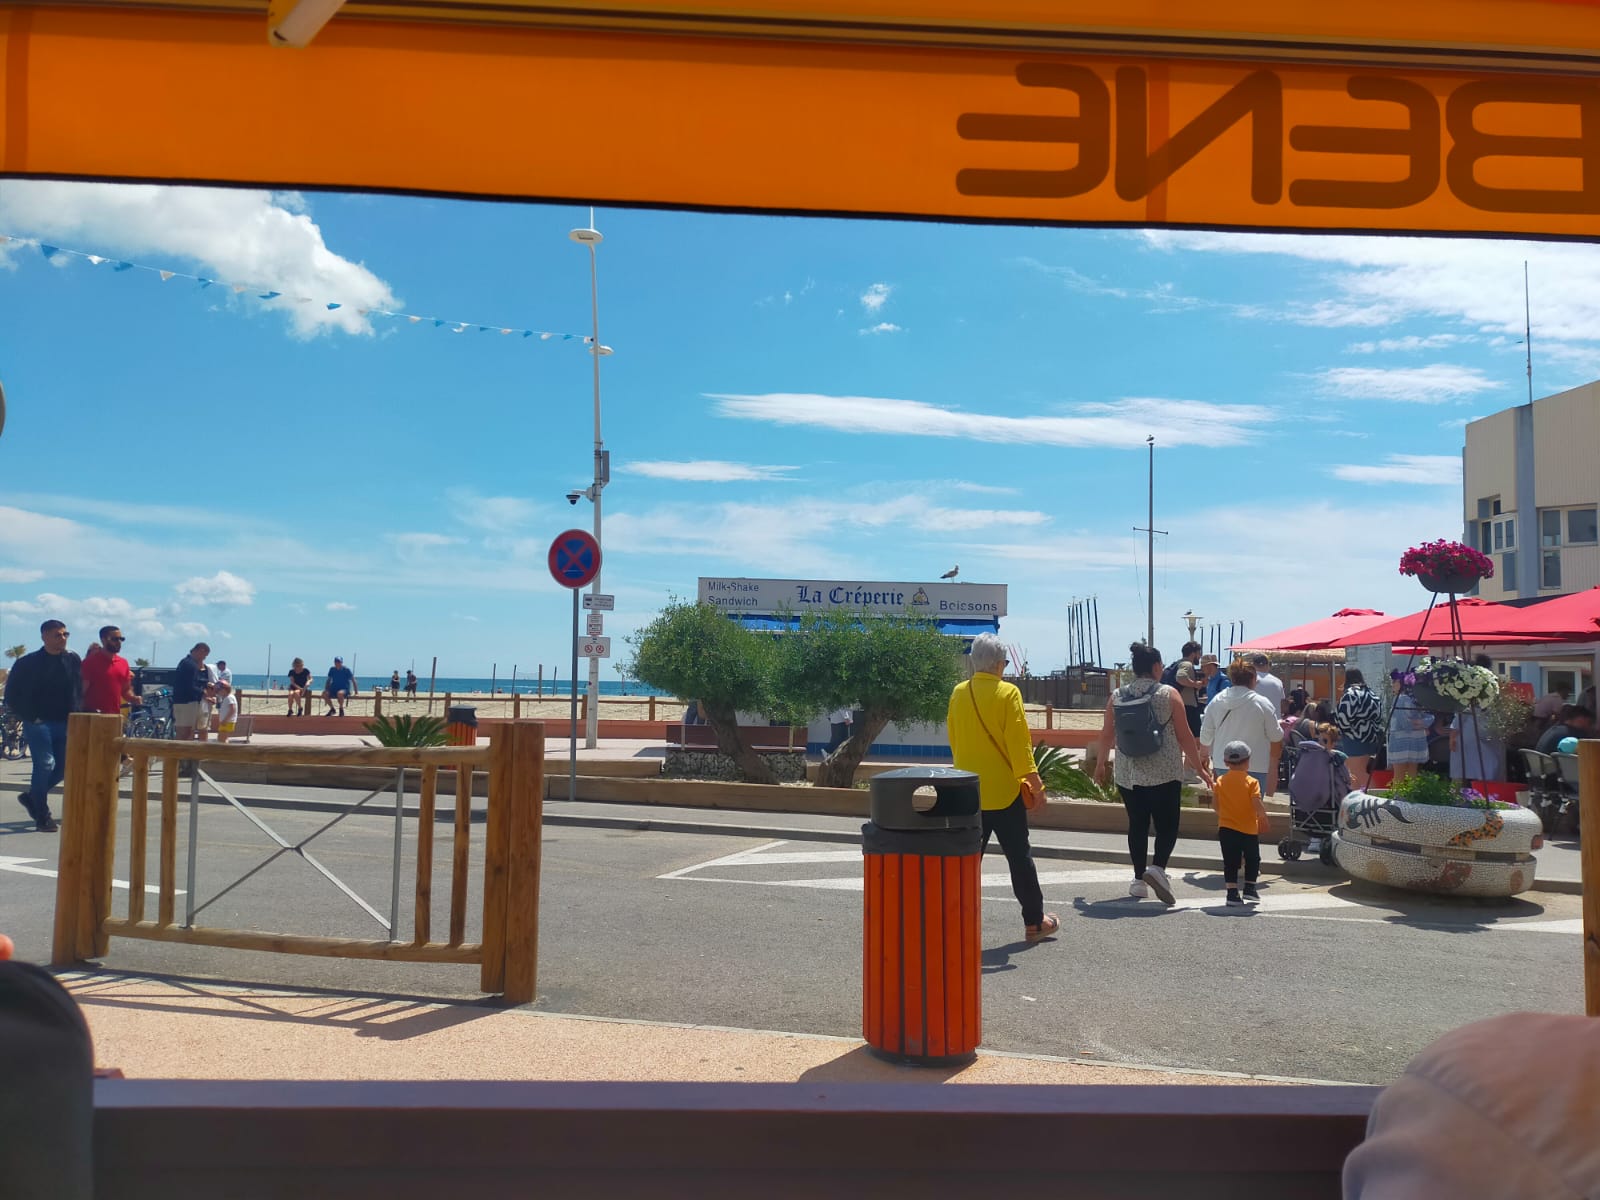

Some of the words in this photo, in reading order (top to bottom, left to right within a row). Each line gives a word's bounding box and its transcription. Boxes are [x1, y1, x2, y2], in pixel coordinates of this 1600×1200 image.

[708, 581, 759, 592] Milk-Shake
[796, 585, 822, 604] La
[708, 595, 758, 607] Sandwich
